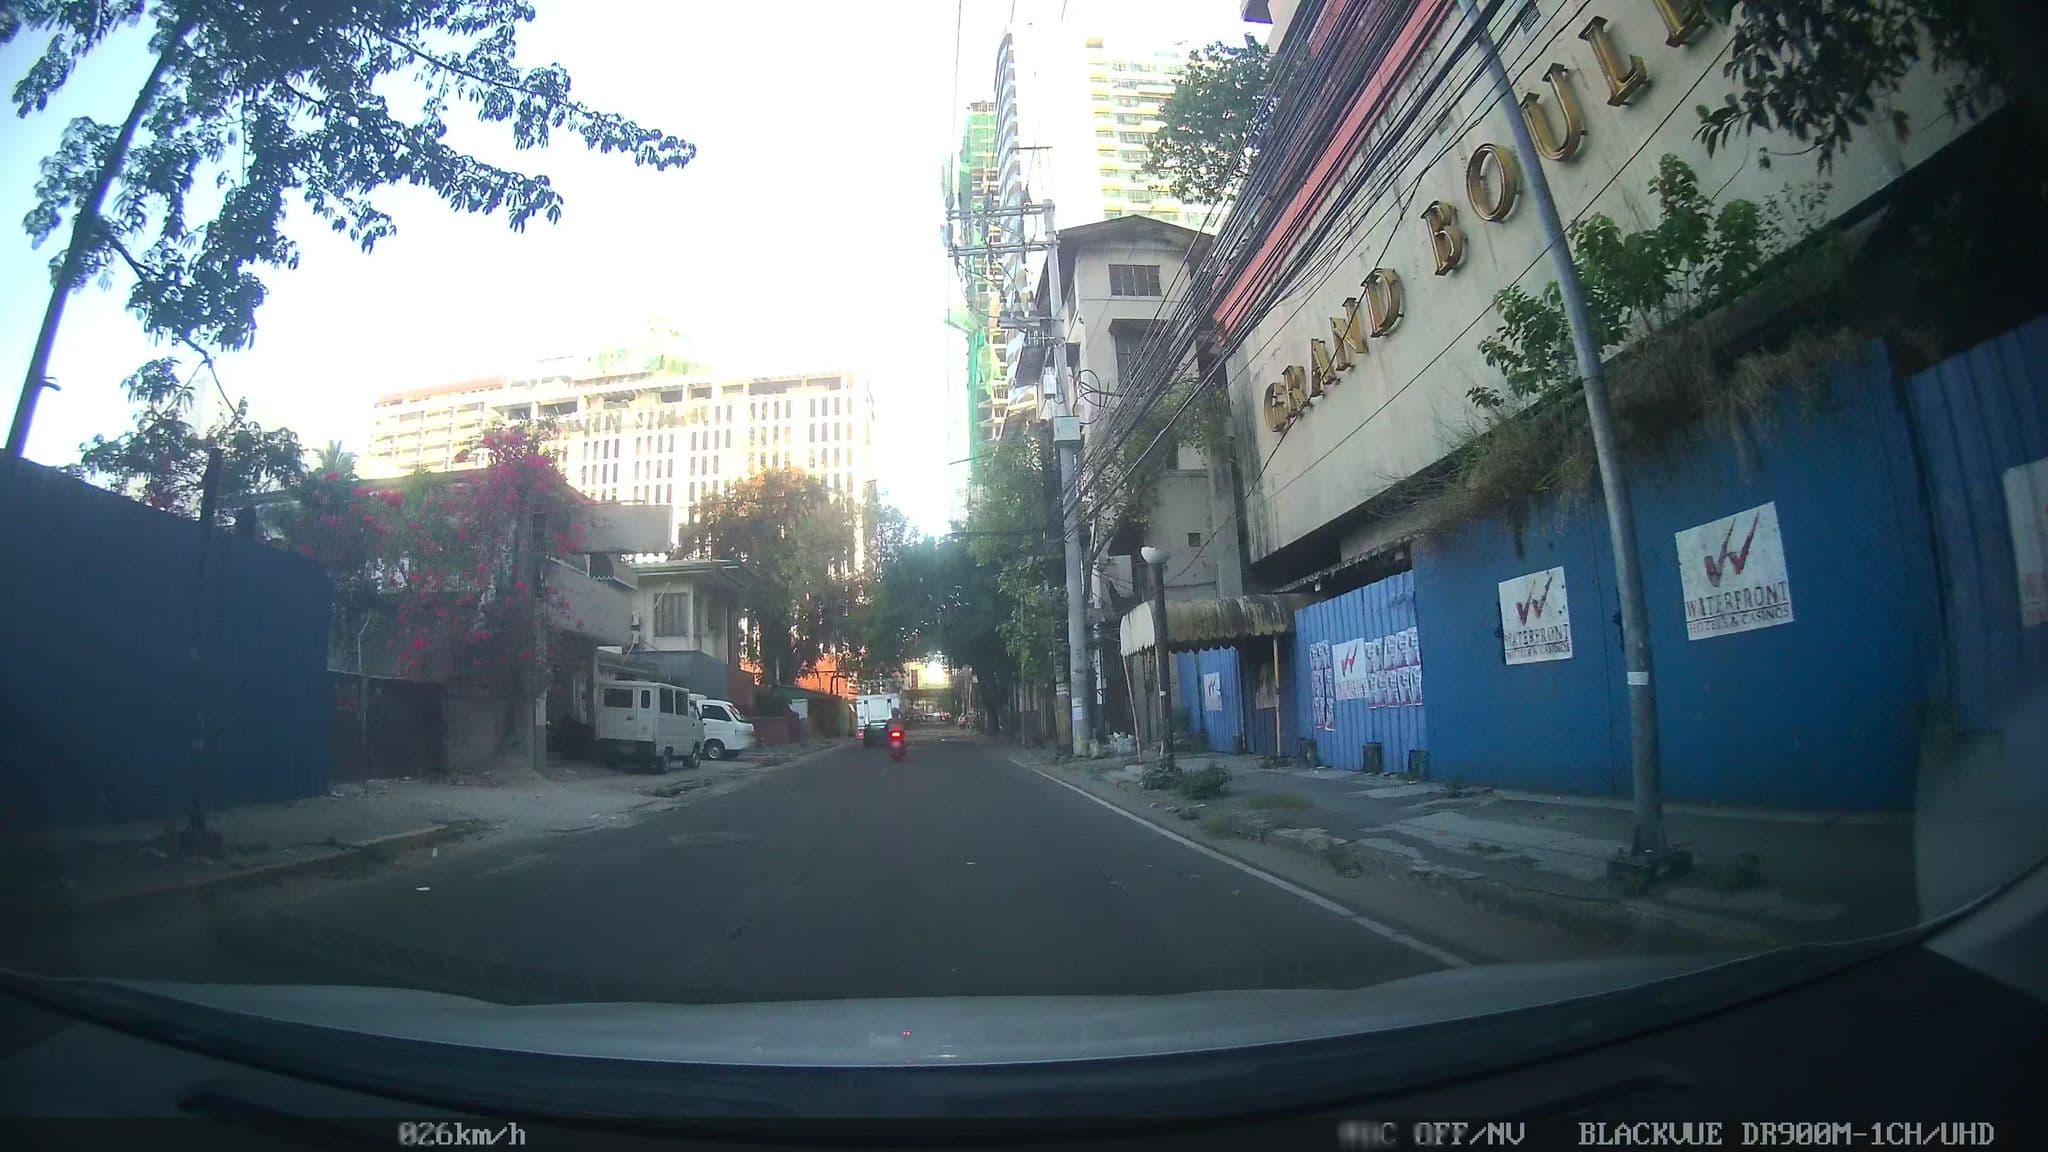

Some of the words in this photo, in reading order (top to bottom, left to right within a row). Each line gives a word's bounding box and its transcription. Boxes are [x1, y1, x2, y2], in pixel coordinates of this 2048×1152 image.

[1263, 266, 1405, 433] GRAND
[1685, 580, 1788, 617] WATERFRONT
[1742, 606, 1790, 625] CASINOS
